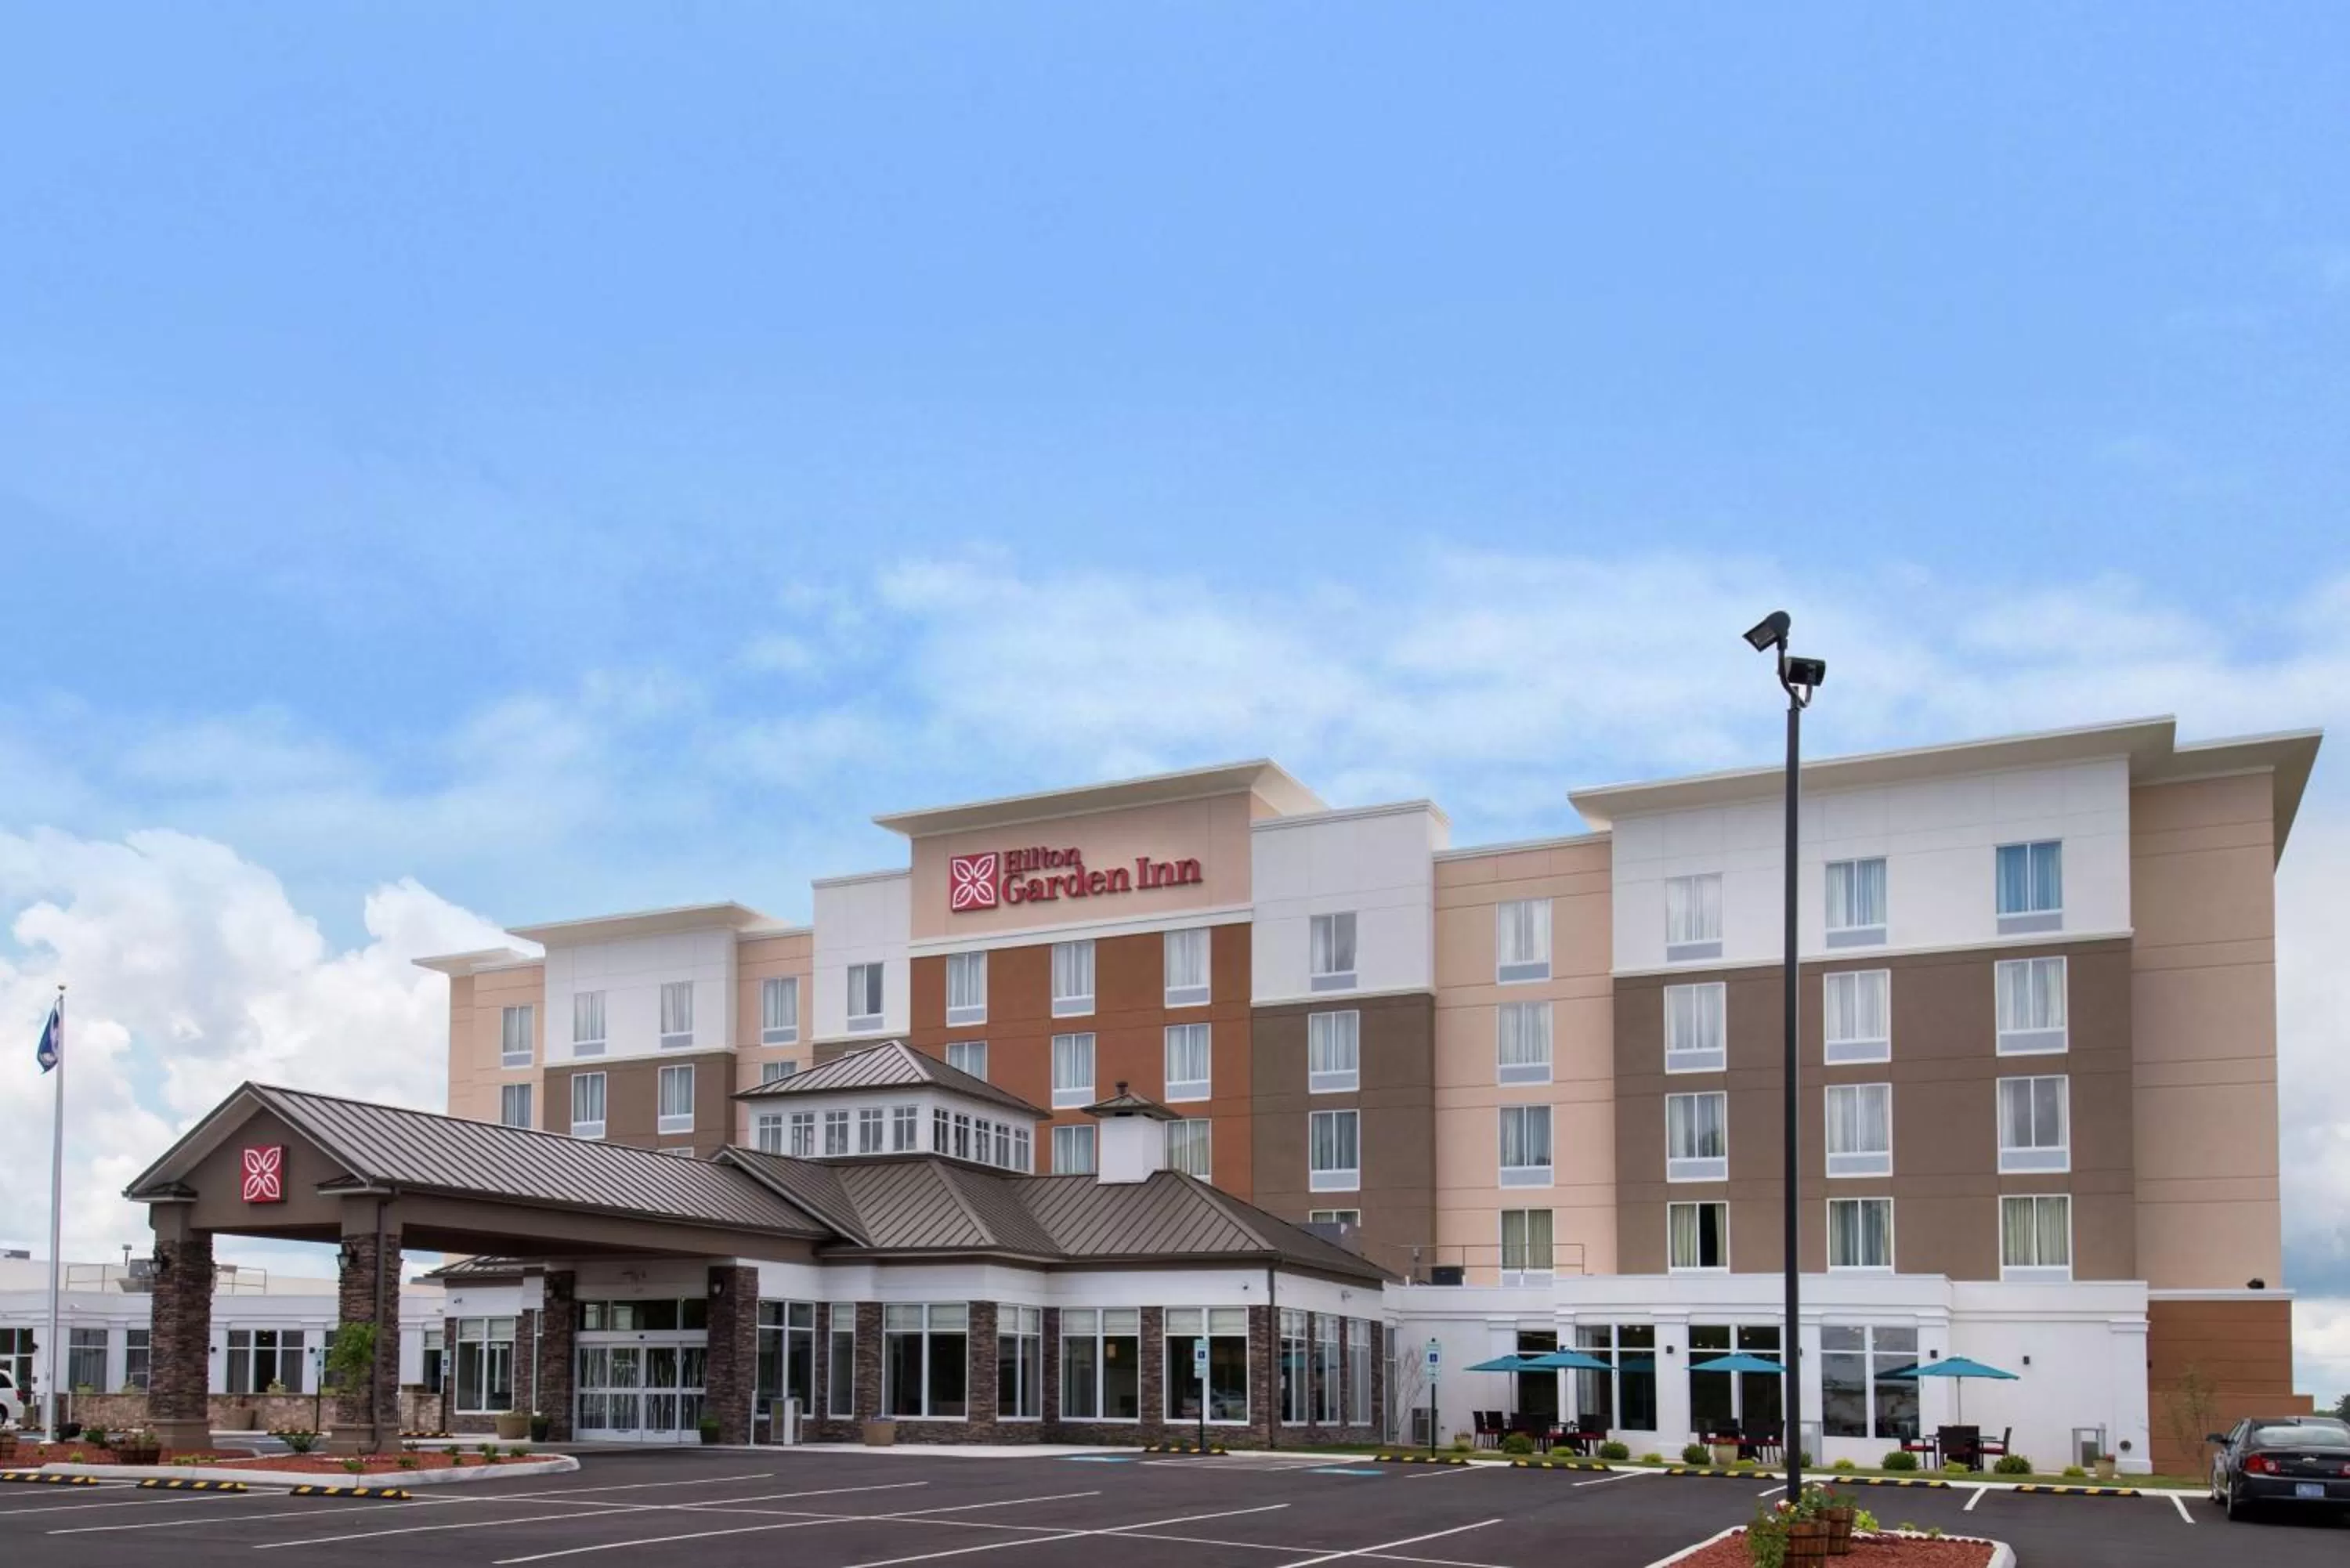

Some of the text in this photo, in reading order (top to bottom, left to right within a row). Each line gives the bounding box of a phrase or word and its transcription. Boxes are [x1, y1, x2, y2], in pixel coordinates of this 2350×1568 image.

[1003, 846, 1081, 873] Hilton
[1002, 857, 1202, 904] Garden Inn
